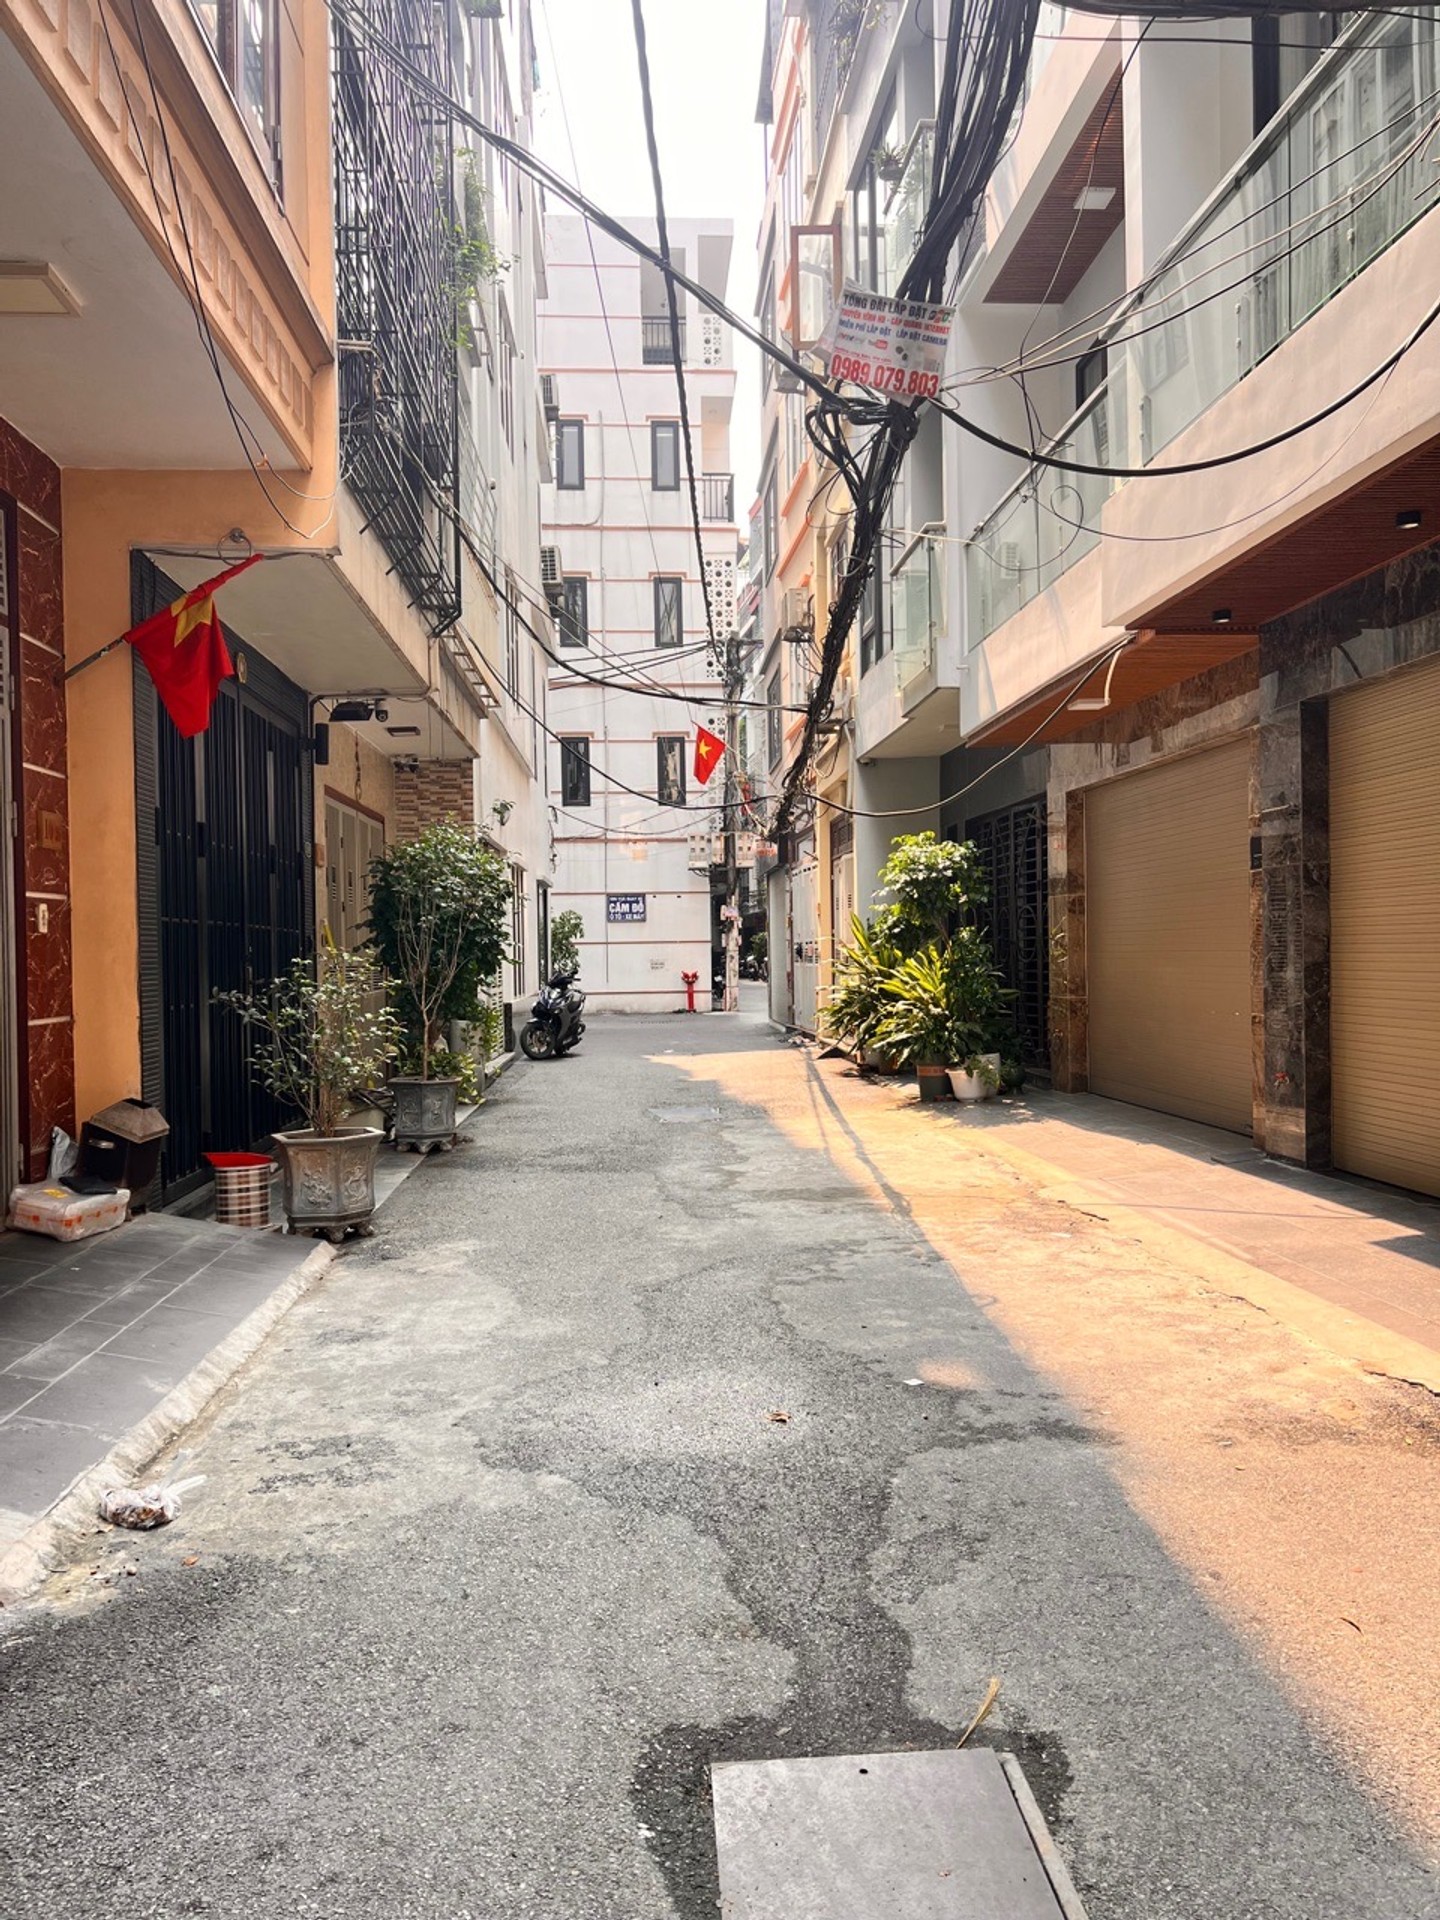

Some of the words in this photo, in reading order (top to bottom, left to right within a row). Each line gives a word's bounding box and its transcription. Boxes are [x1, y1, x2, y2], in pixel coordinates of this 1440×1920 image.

[888, 300, 907, 315] LẮP
[909, 305, 928, 320] ĐẶT
[922, 333, 948, 345] CAMERA
[831, 354, 939, 398] 0989.079.803
